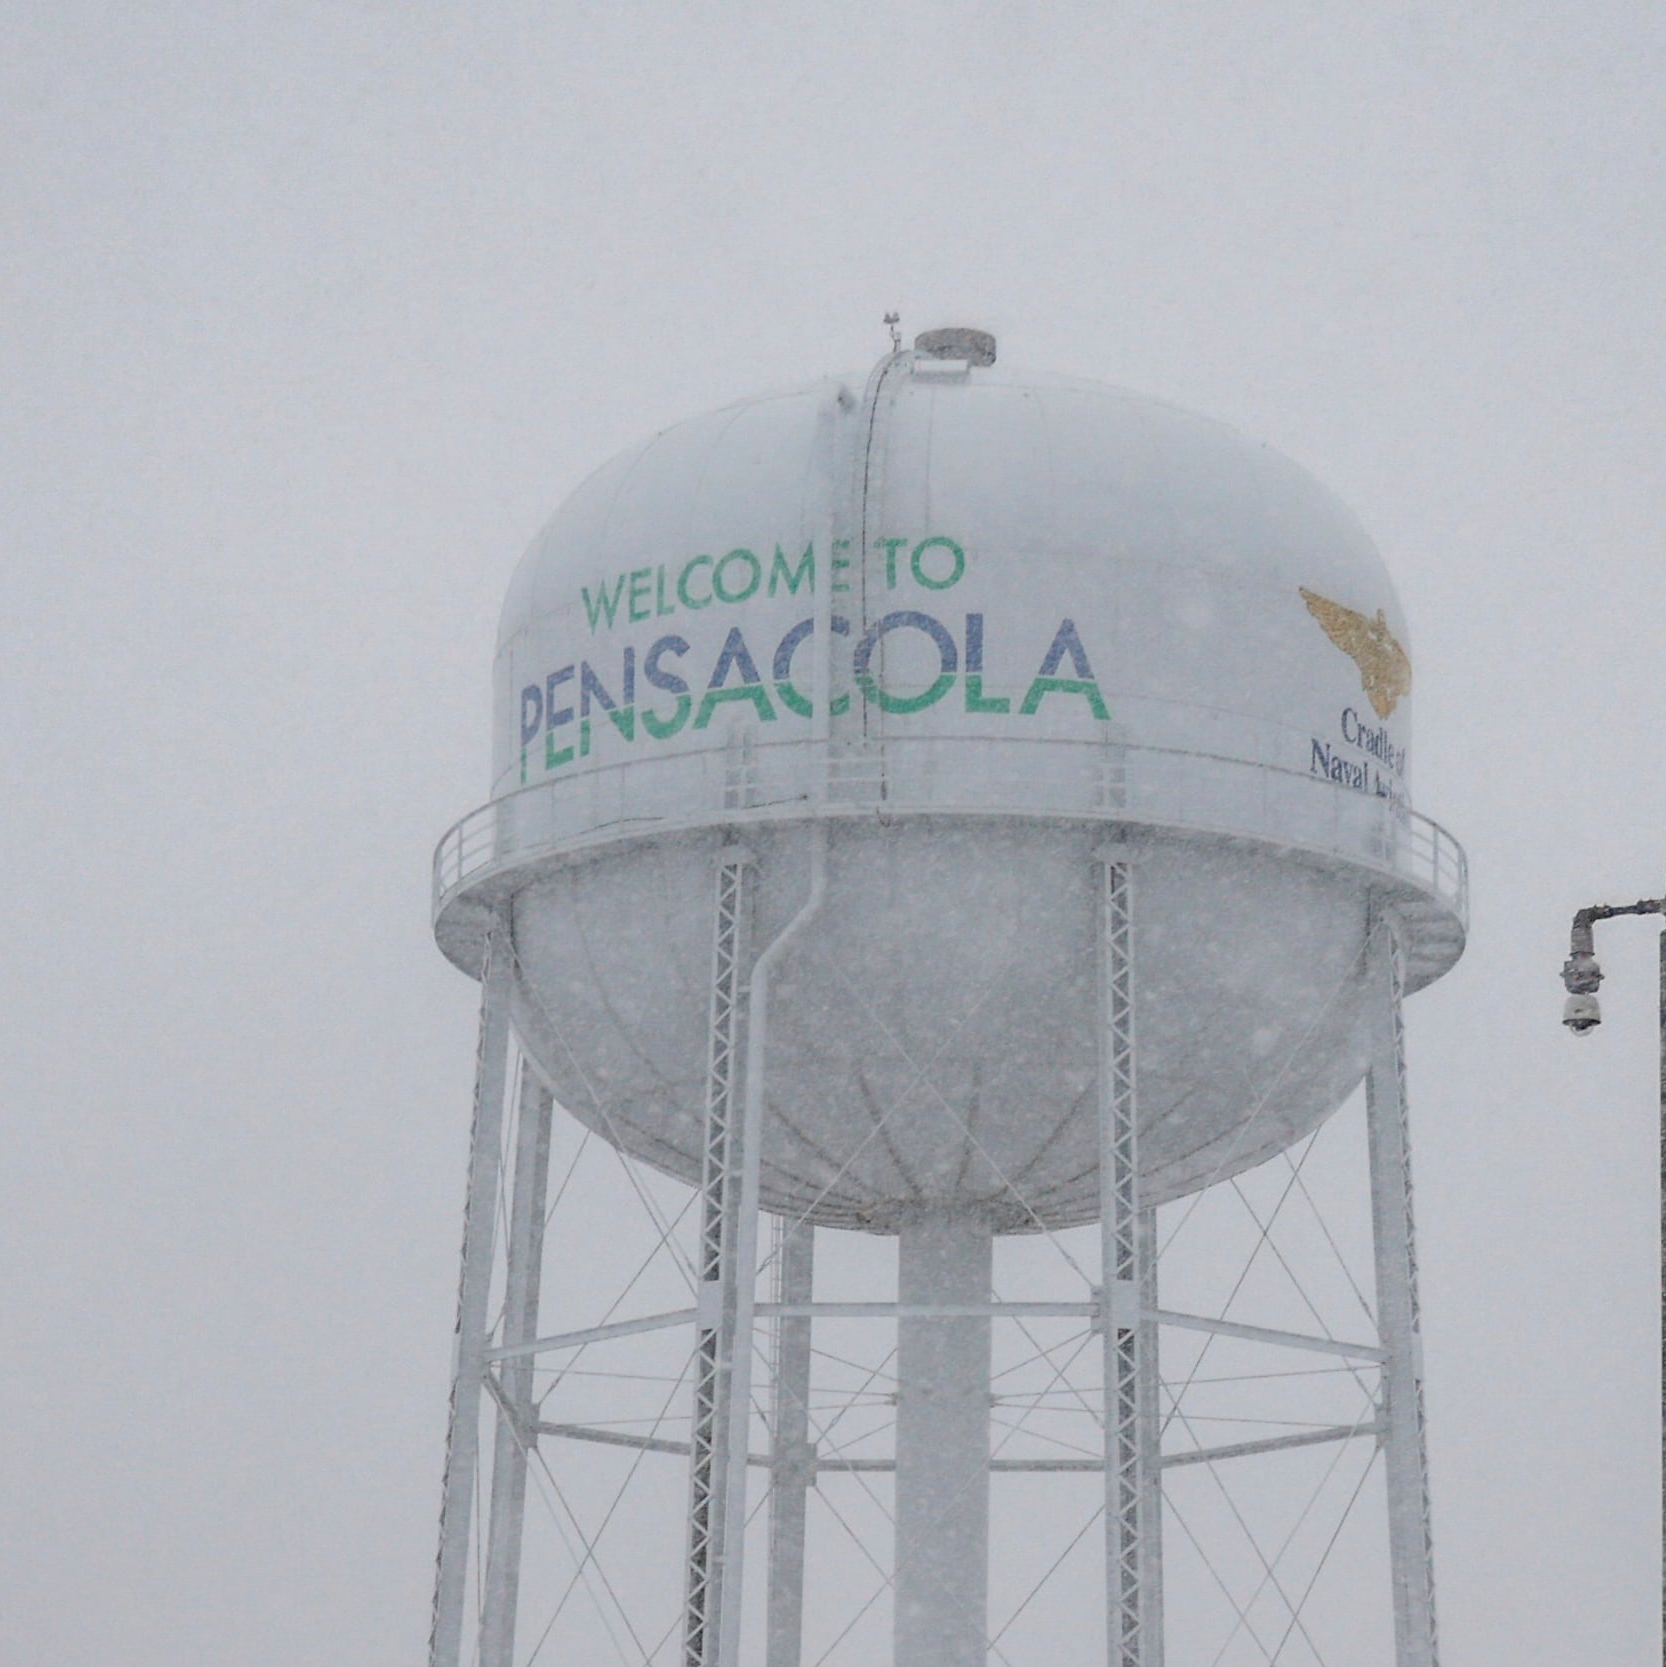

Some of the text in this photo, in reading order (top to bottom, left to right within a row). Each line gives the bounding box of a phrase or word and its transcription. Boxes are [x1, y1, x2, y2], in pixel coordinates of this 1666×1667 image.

[580, 536, 966, 635] WELCOME TO
[520, 611, 1112, 784] PENSACOLA
[1309, 737, 1368, 793] Naval
[1341, 707, 1394, 769] Cradle
